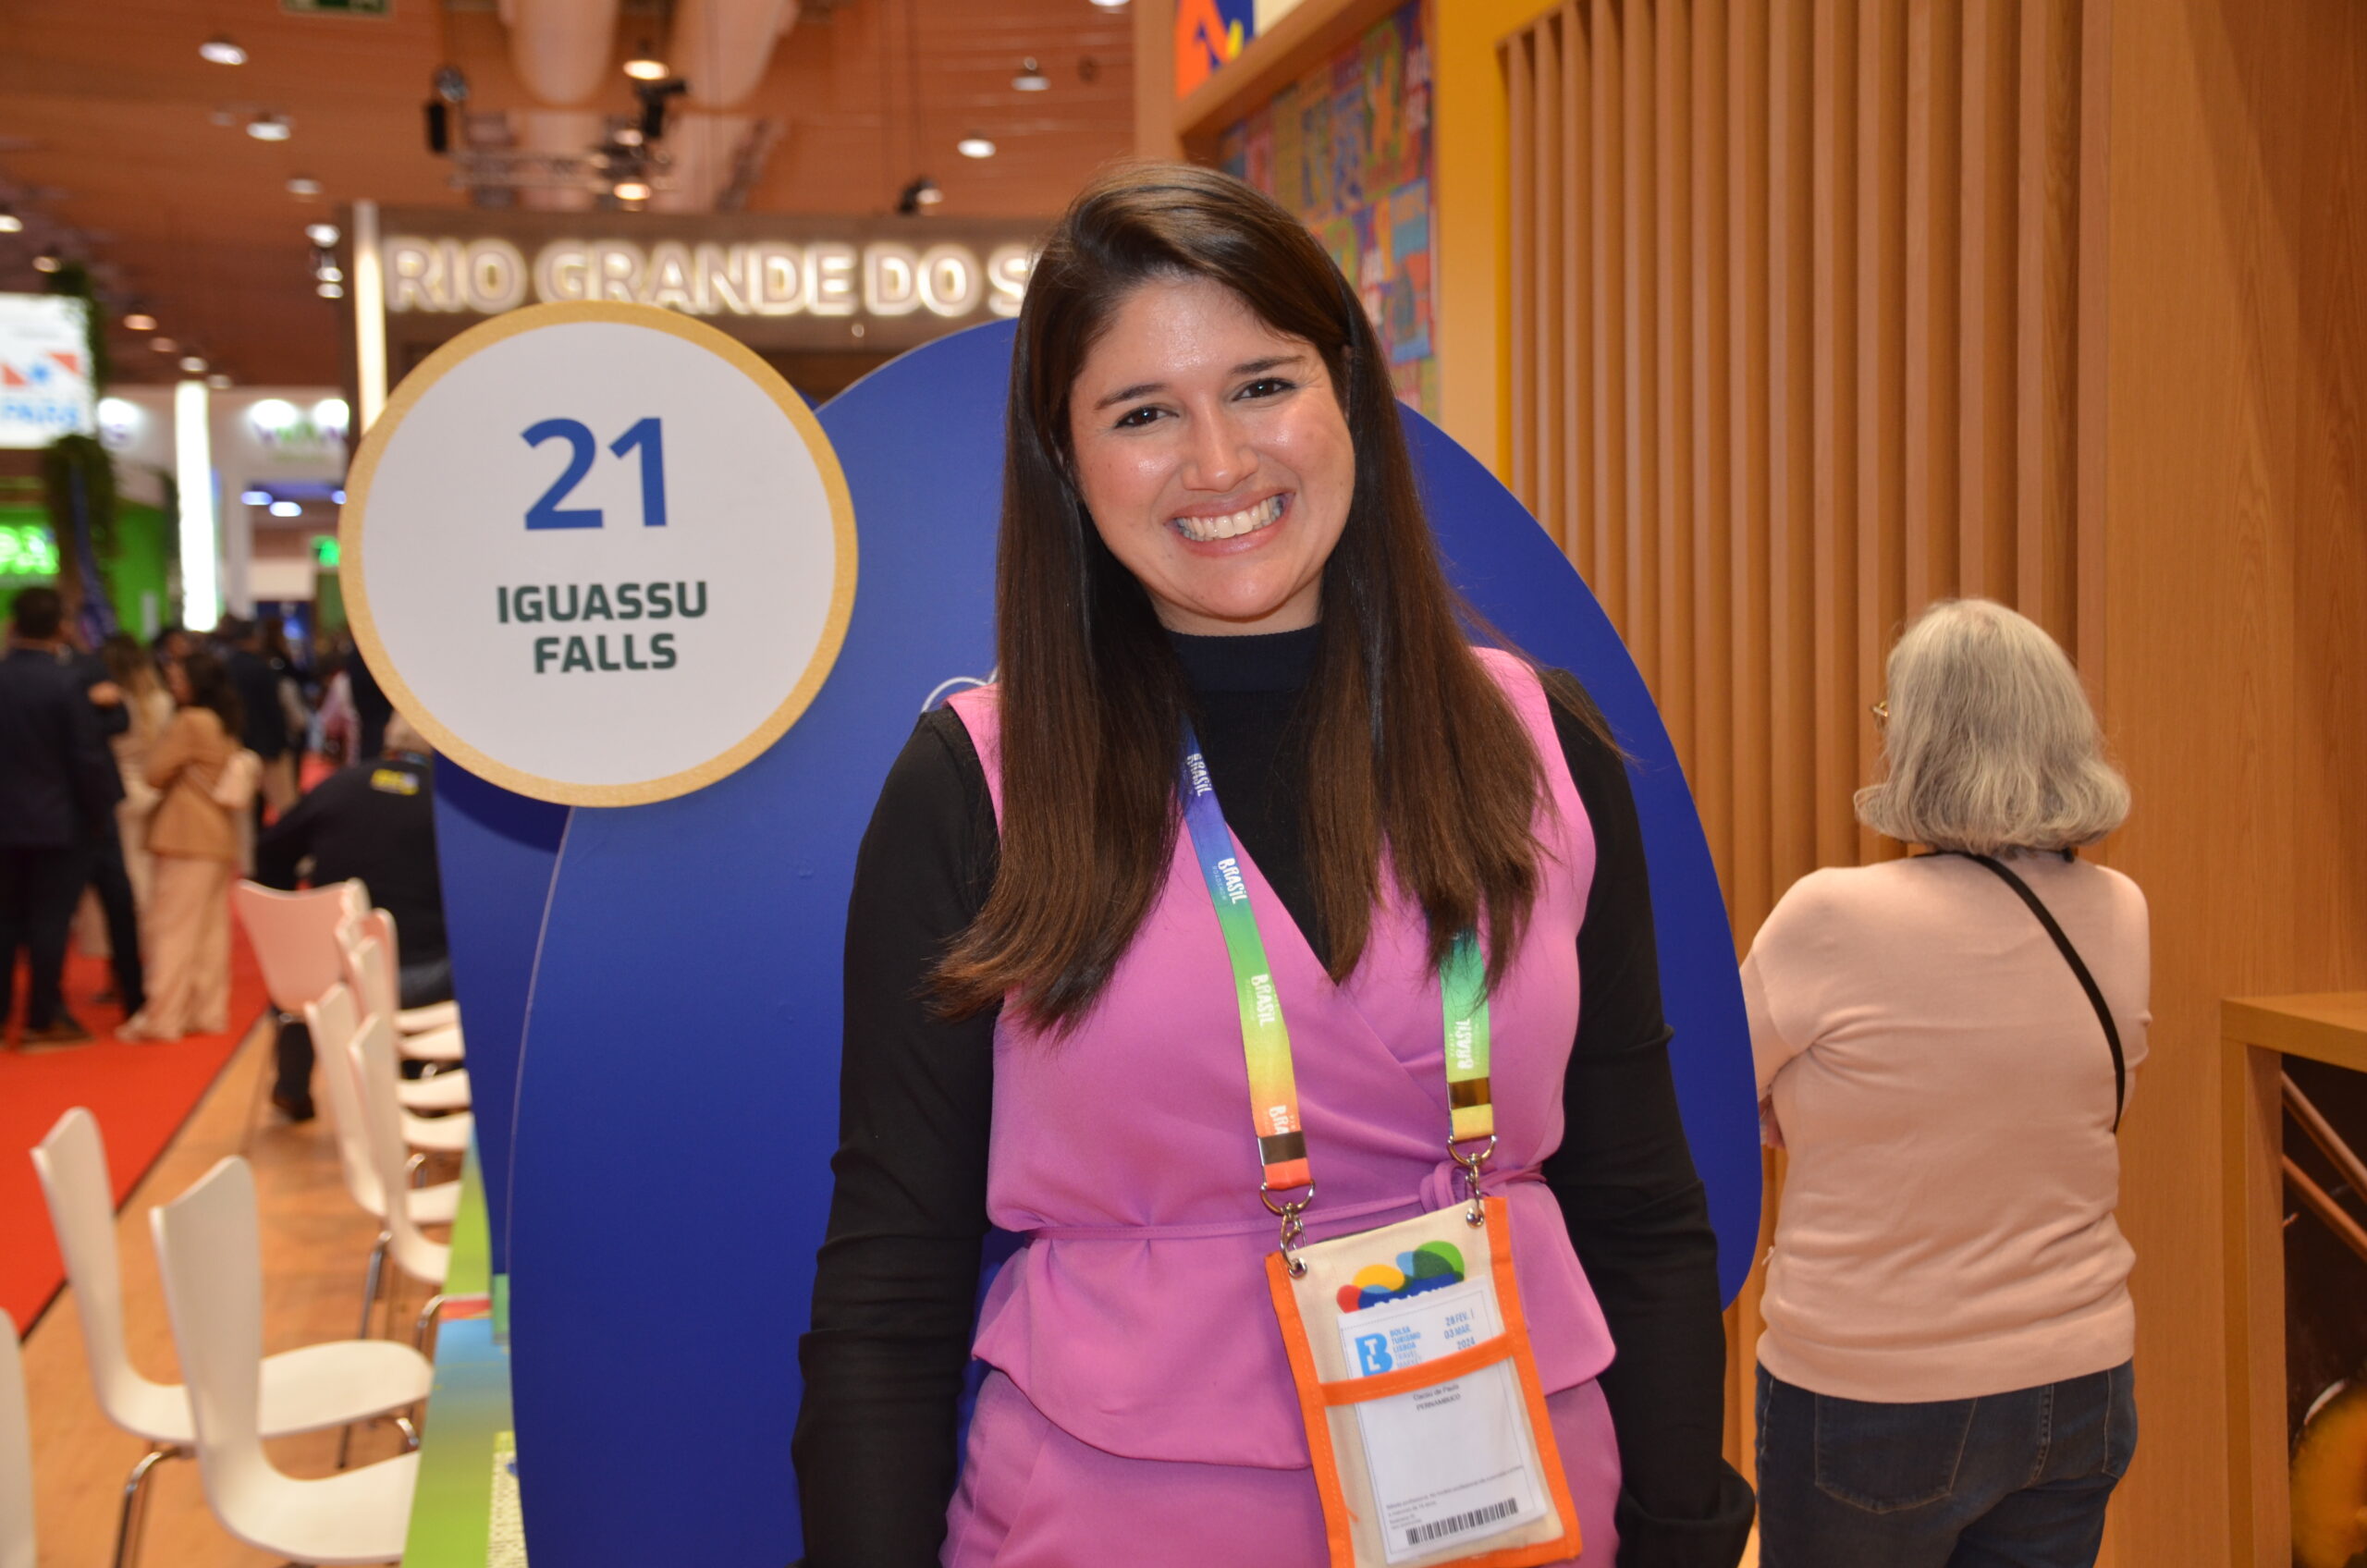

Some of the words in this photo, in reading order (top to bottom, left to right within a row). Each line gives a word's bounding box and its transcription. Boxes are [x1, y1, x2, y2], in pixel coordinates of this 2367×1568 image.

[384, 239, 524, 313] RIO
[536, 240, 855, 315] GRANDE
[865, 243, 981, 316] DO
[520, 416, 667, 531] 21
[497, 581, 708, 624] IGUASSU
[533, 632, 678, 674] FALLS
[1218, 857, 1248, 904] BRASIL
[1251, 974, 1276, 1027] BRASIL
[1454, 1018, 1474, 1070] BRASIL
